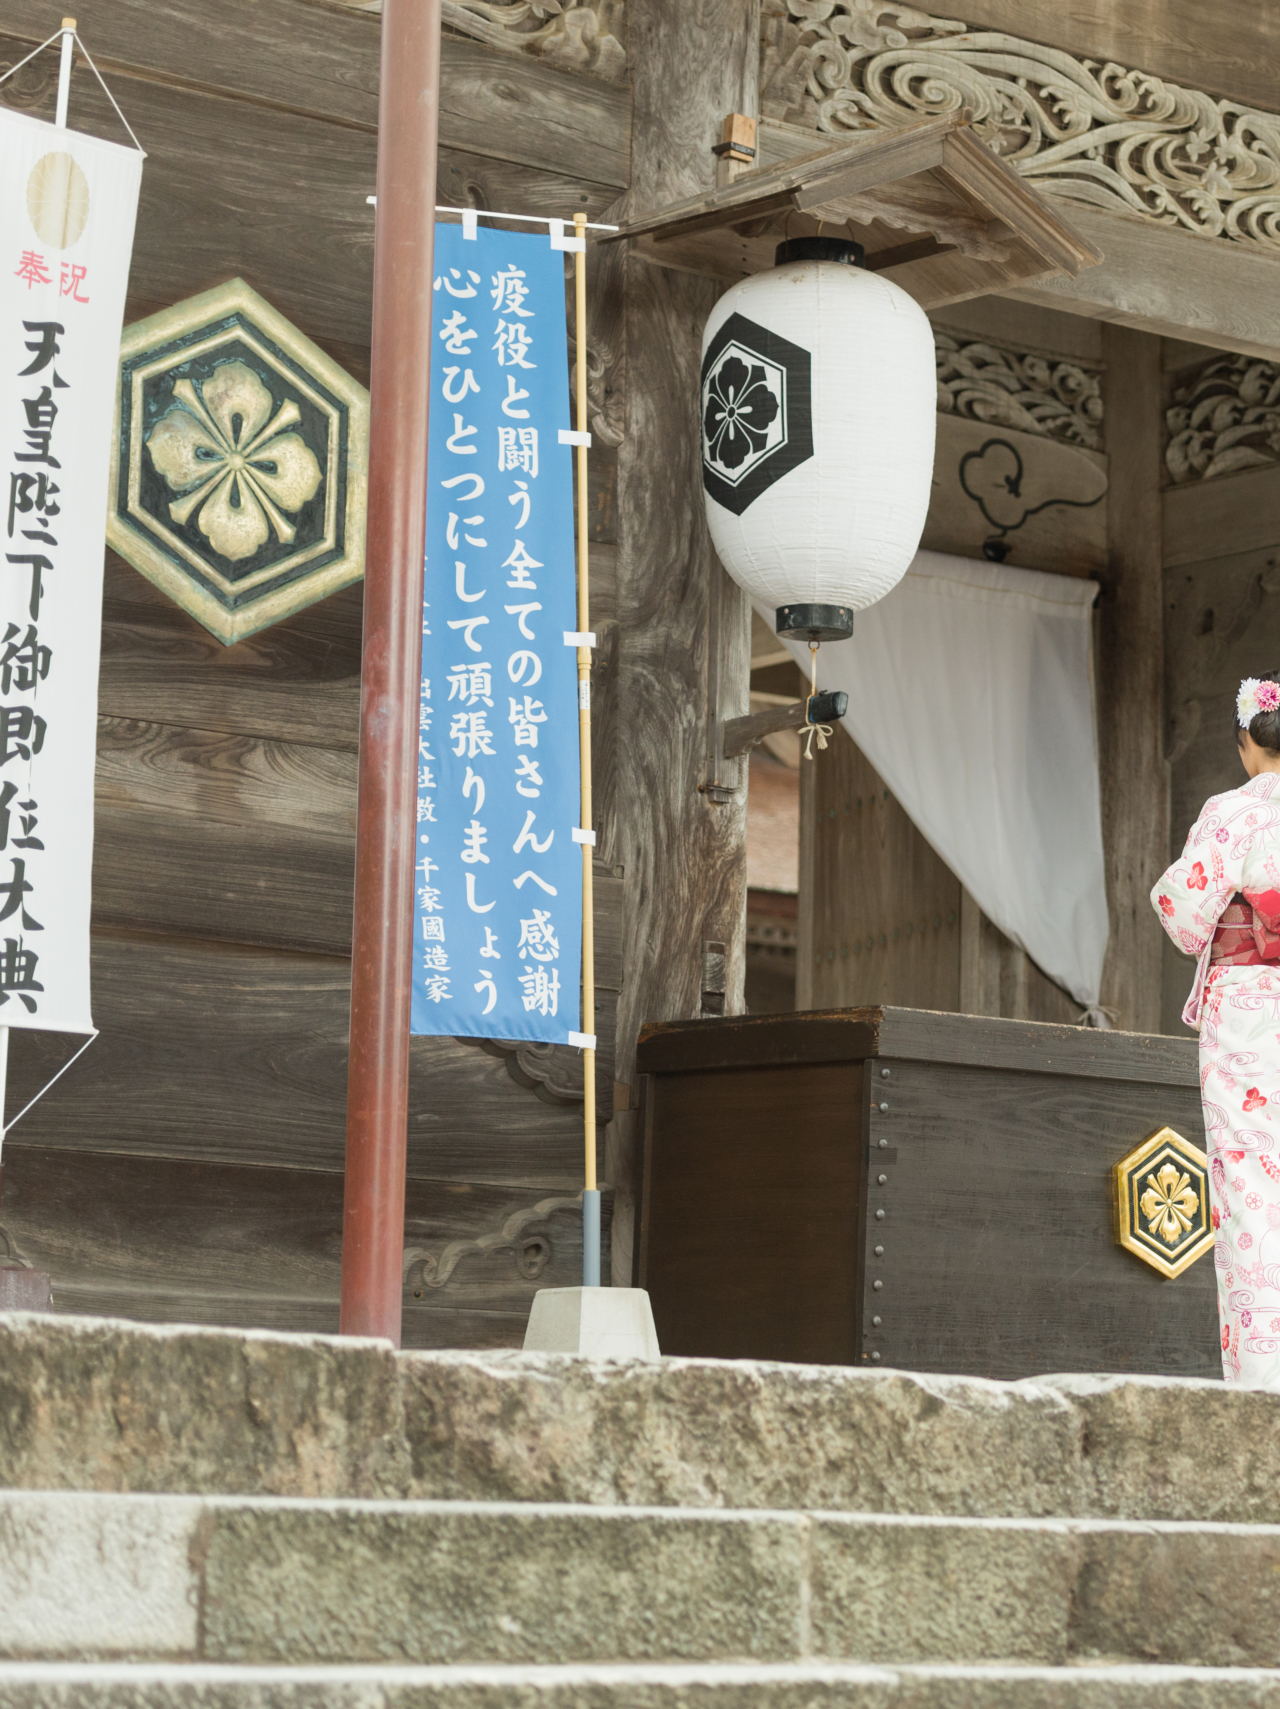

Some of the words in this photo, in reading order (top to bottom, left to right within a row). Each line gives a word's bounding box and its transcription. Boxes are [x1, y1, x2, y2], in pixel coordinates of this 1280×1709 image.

[13, 249, 90, 304] 奉祝
[0, 319, 72, 1014] 天皇陛下御即位大典
[433, 267, 502, 1016] 心をひとつにして頑張りましょう
[490, 263, 562, 1018] 疫役と闘う全ての皆さんへ感謝
